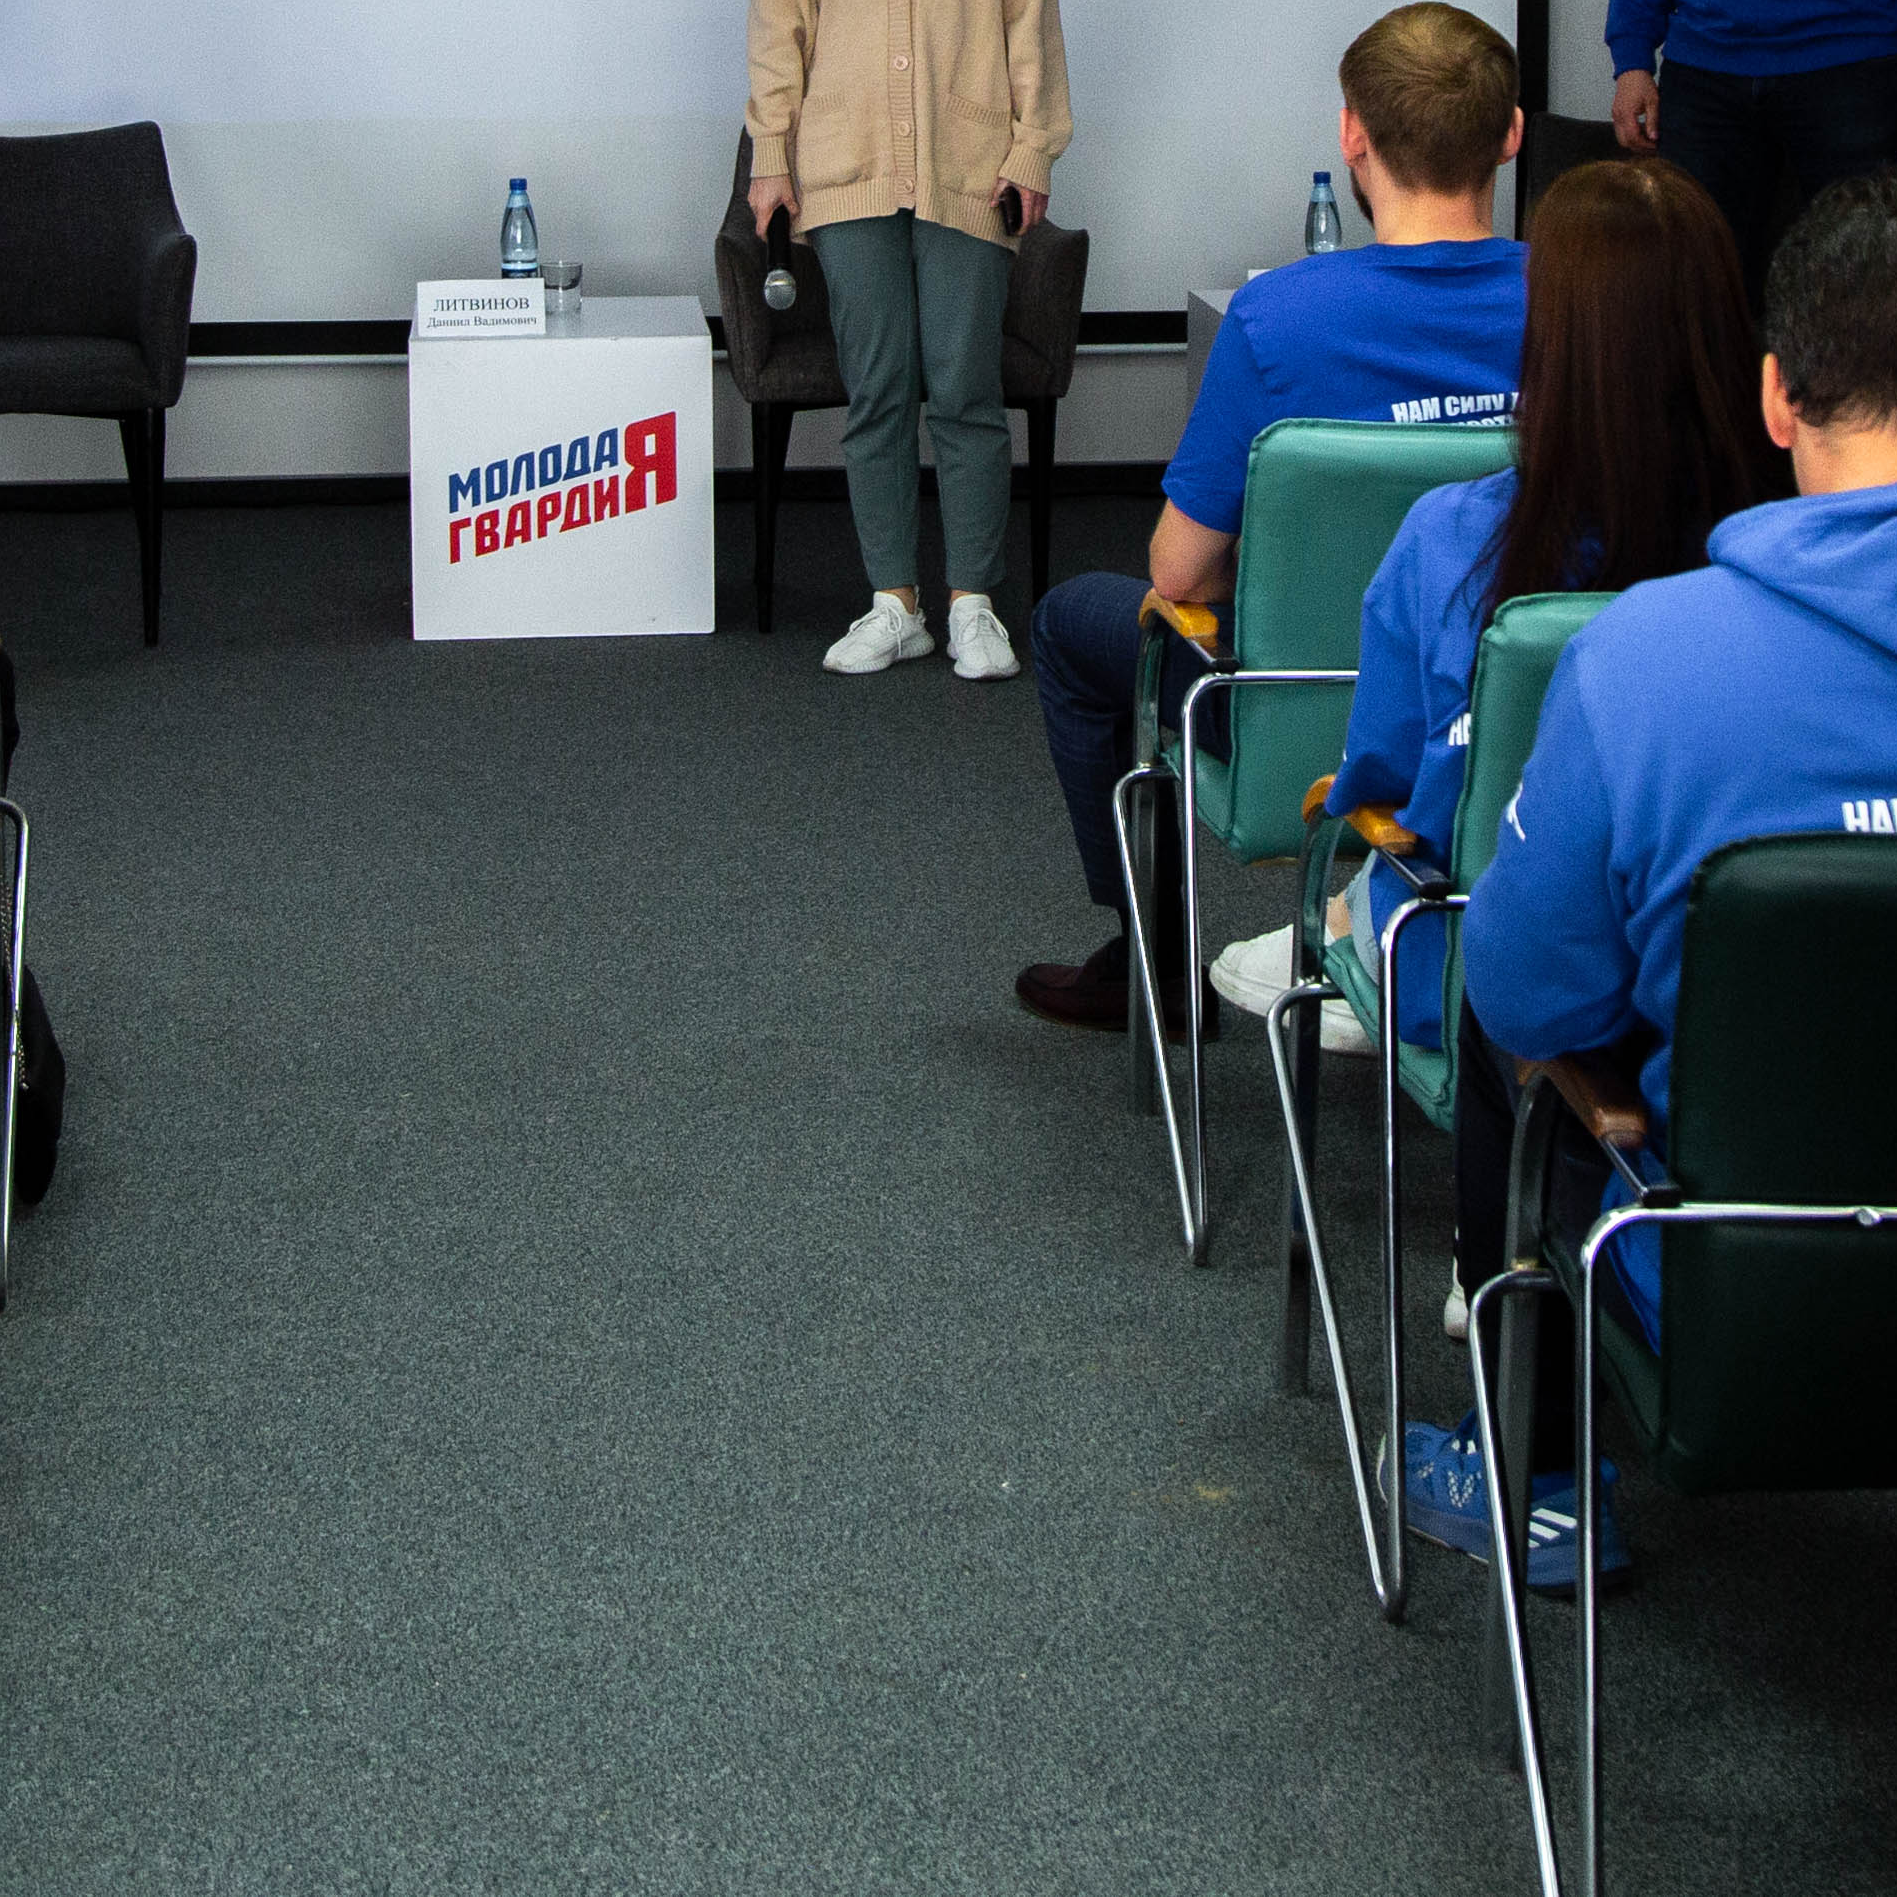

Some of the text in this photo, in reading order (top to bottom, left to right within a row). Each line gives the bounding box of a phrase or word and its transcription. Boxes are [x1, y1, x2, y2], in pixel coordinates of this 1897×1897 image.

[433, 296, 530, 312] ЛИТВИНОВ
[426, 315, 538, 329] Даниил Вадимович
[1391, 396, 1442, 424] НАМ
[1444, 393, 1505, 417] СИЛУ
